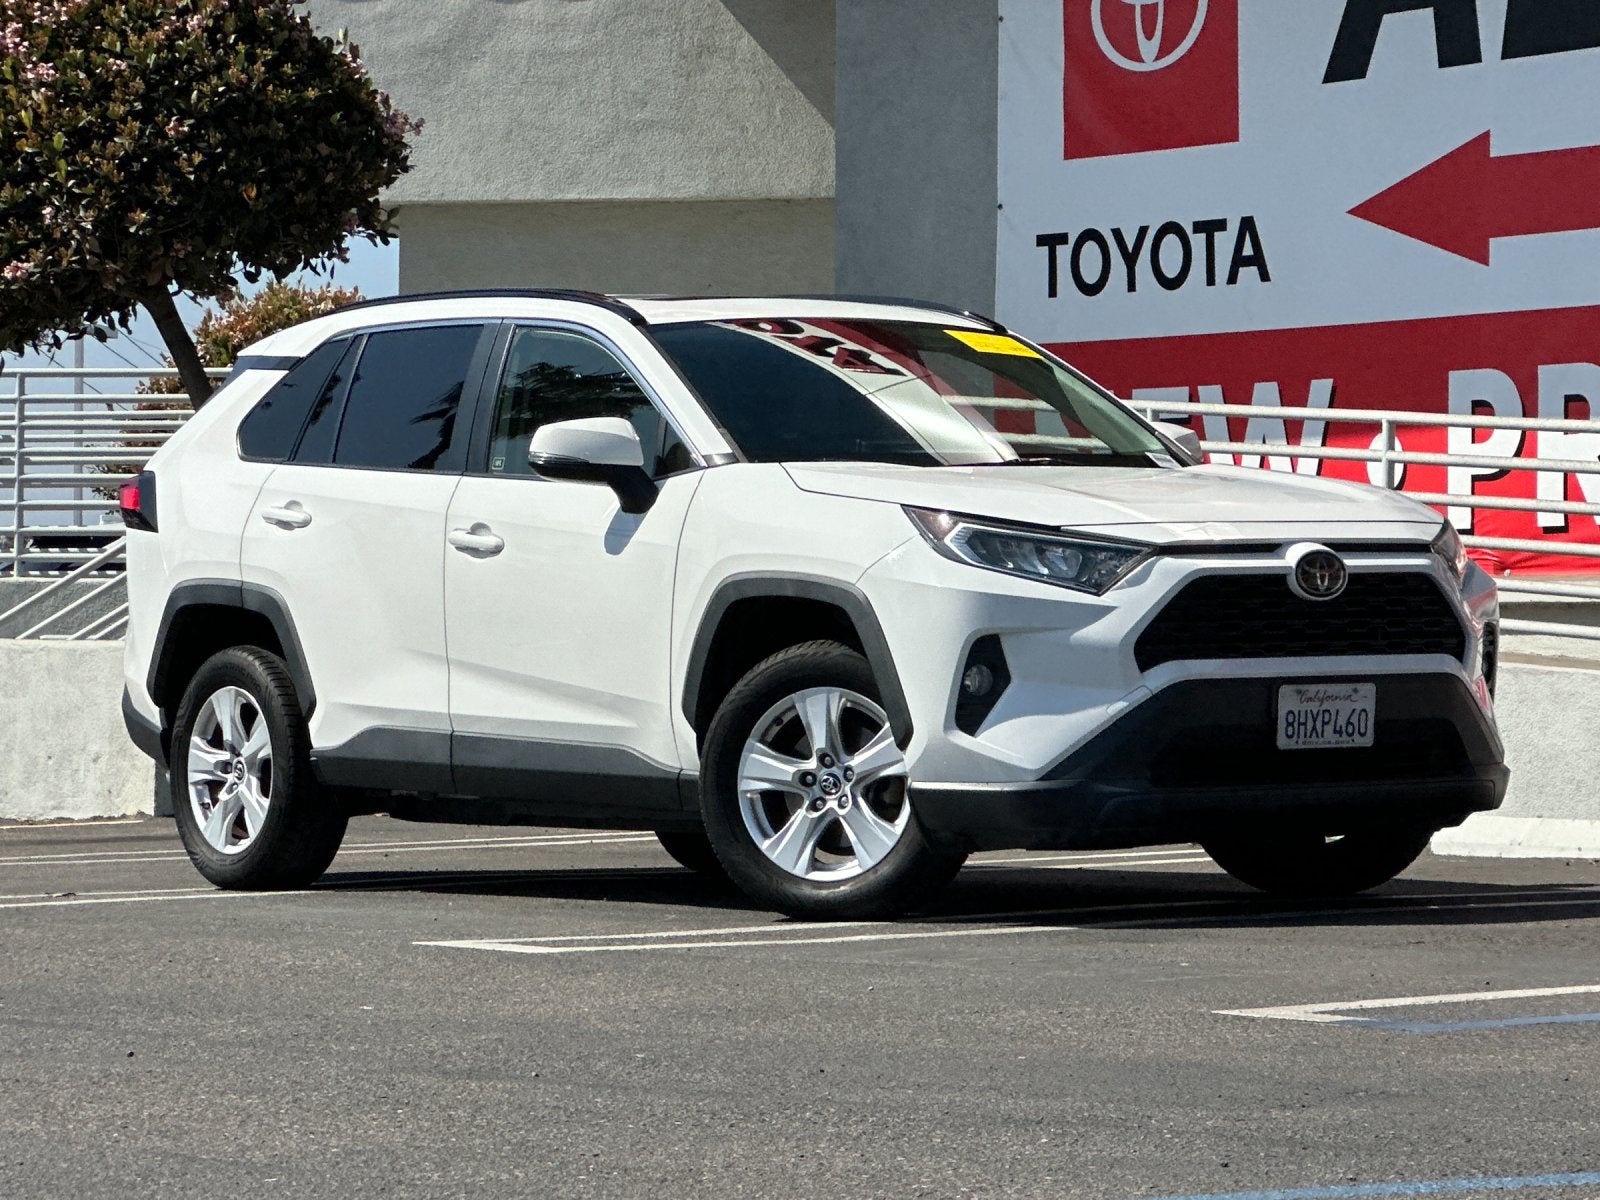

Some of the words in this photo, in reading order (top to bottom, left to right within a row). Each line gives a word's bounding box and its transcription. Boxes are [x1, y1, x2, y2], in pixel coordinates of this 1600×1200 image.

[1036, 216, 1271, 298] TOYOTA
[1299, 689, 1358, 707] California
[1285, 708, 1368, 739] 8HXP460
